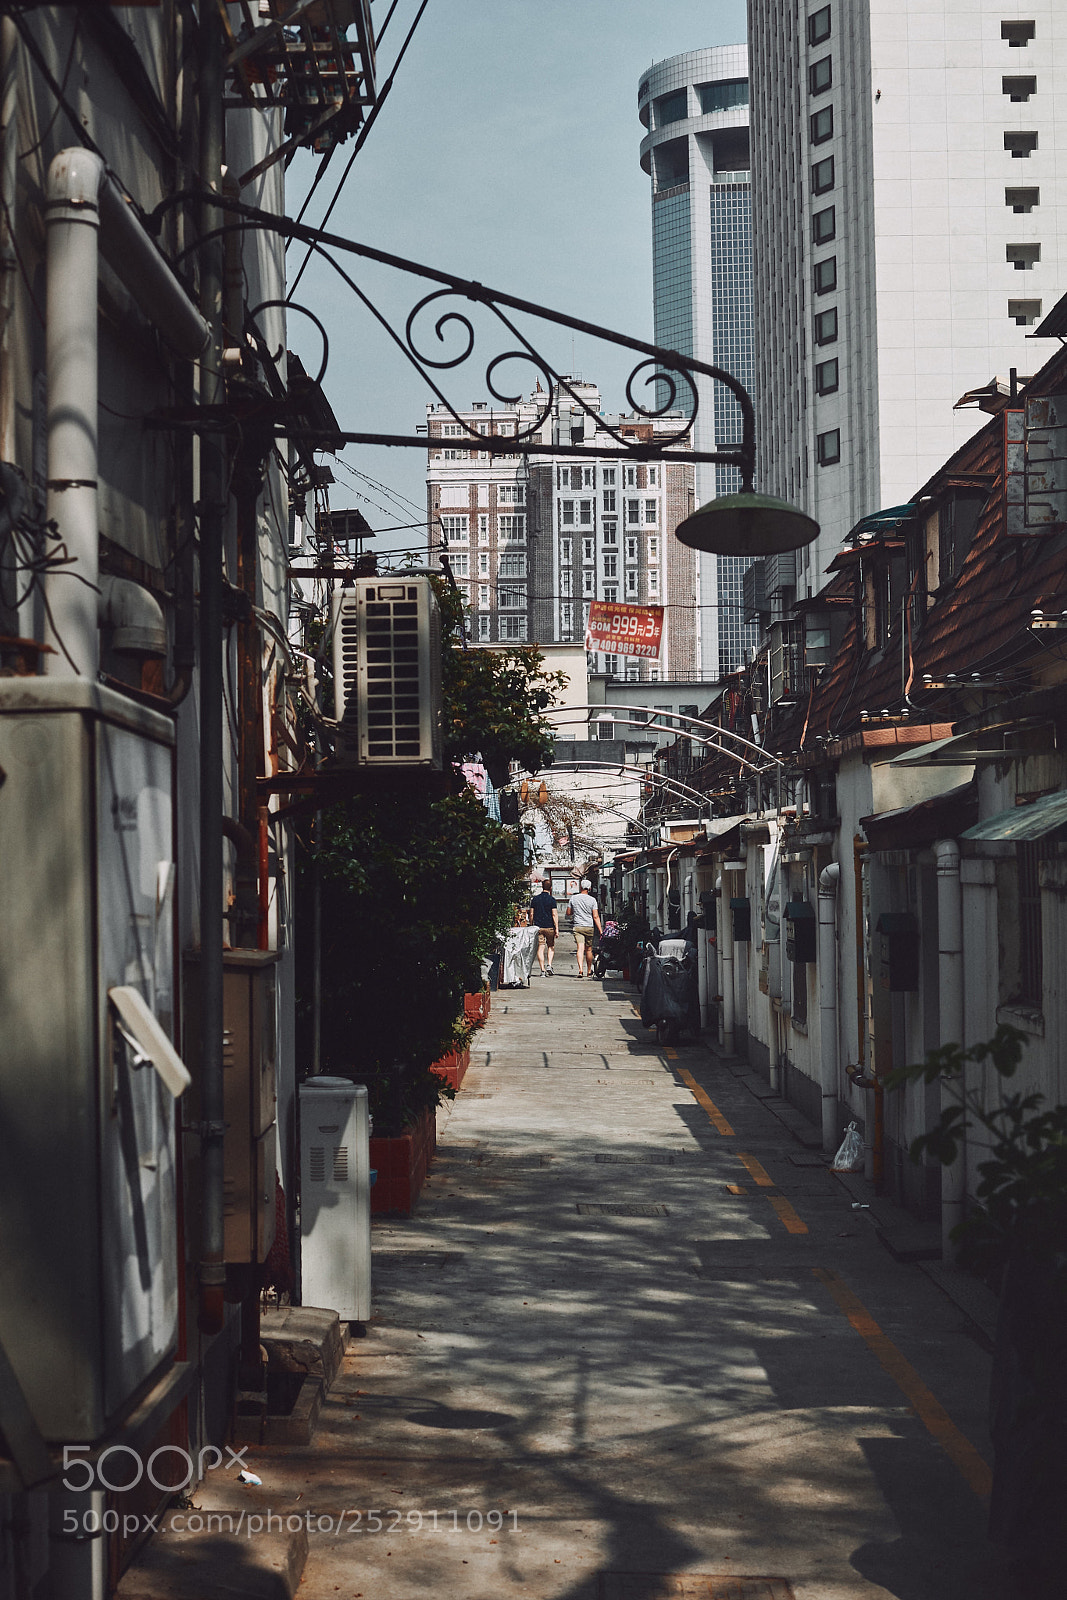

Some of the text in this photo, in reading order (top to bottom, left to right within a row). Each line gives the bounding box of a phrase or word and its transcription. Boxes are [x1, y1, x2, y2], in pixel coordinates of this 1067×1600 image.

[590, 621, 611, 632] 60M
[600, 639, 617, 652] 400
[617, 642, 635, 654] 969
[635, 645, 657, 657] 3220
